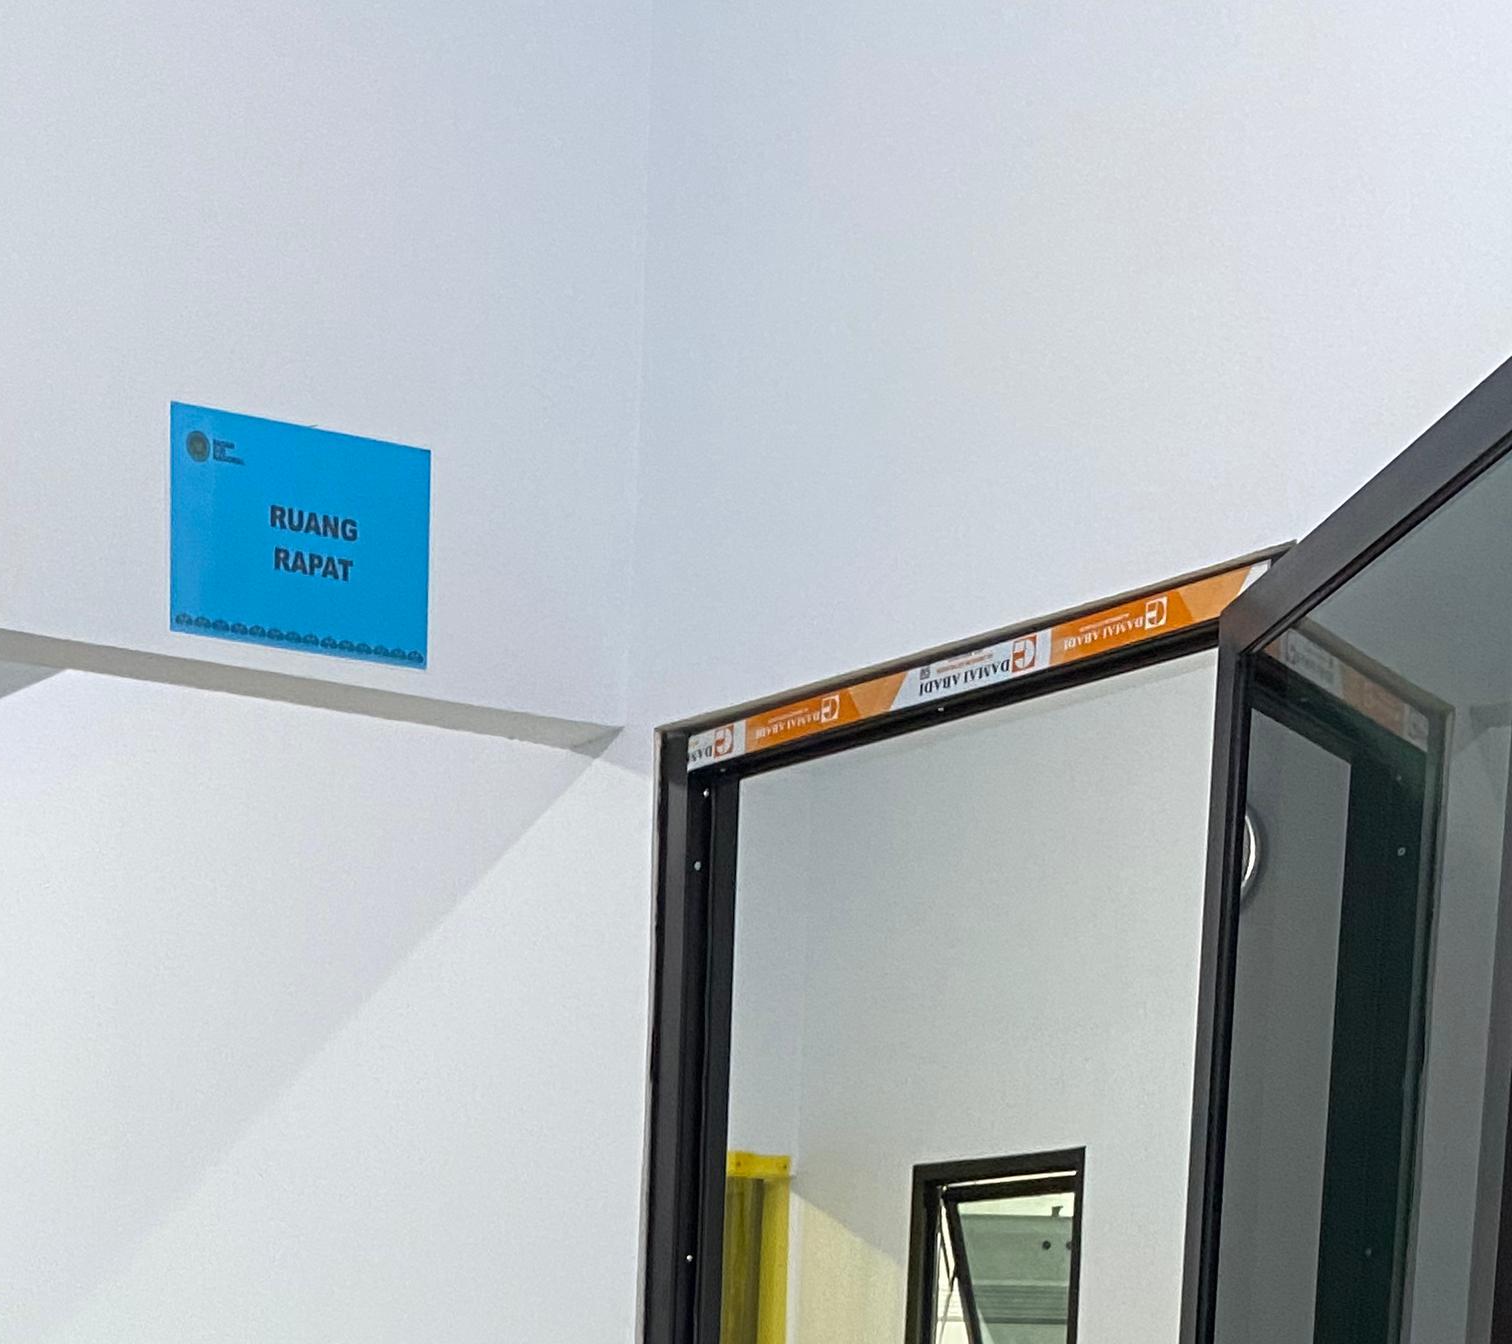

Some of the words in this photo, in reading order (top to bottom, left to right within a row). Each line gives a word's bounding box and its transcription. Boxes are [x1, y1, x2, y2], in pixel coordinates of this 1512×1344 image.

[270, 503, 358, 542] RUANG
[273, 546, 354, 582] RAPAT
[1102, 616, 1144, 640] DAMAI
[963, 658, 1011, 684] DAMAI
[918, 673, 962, 696] ABADI
